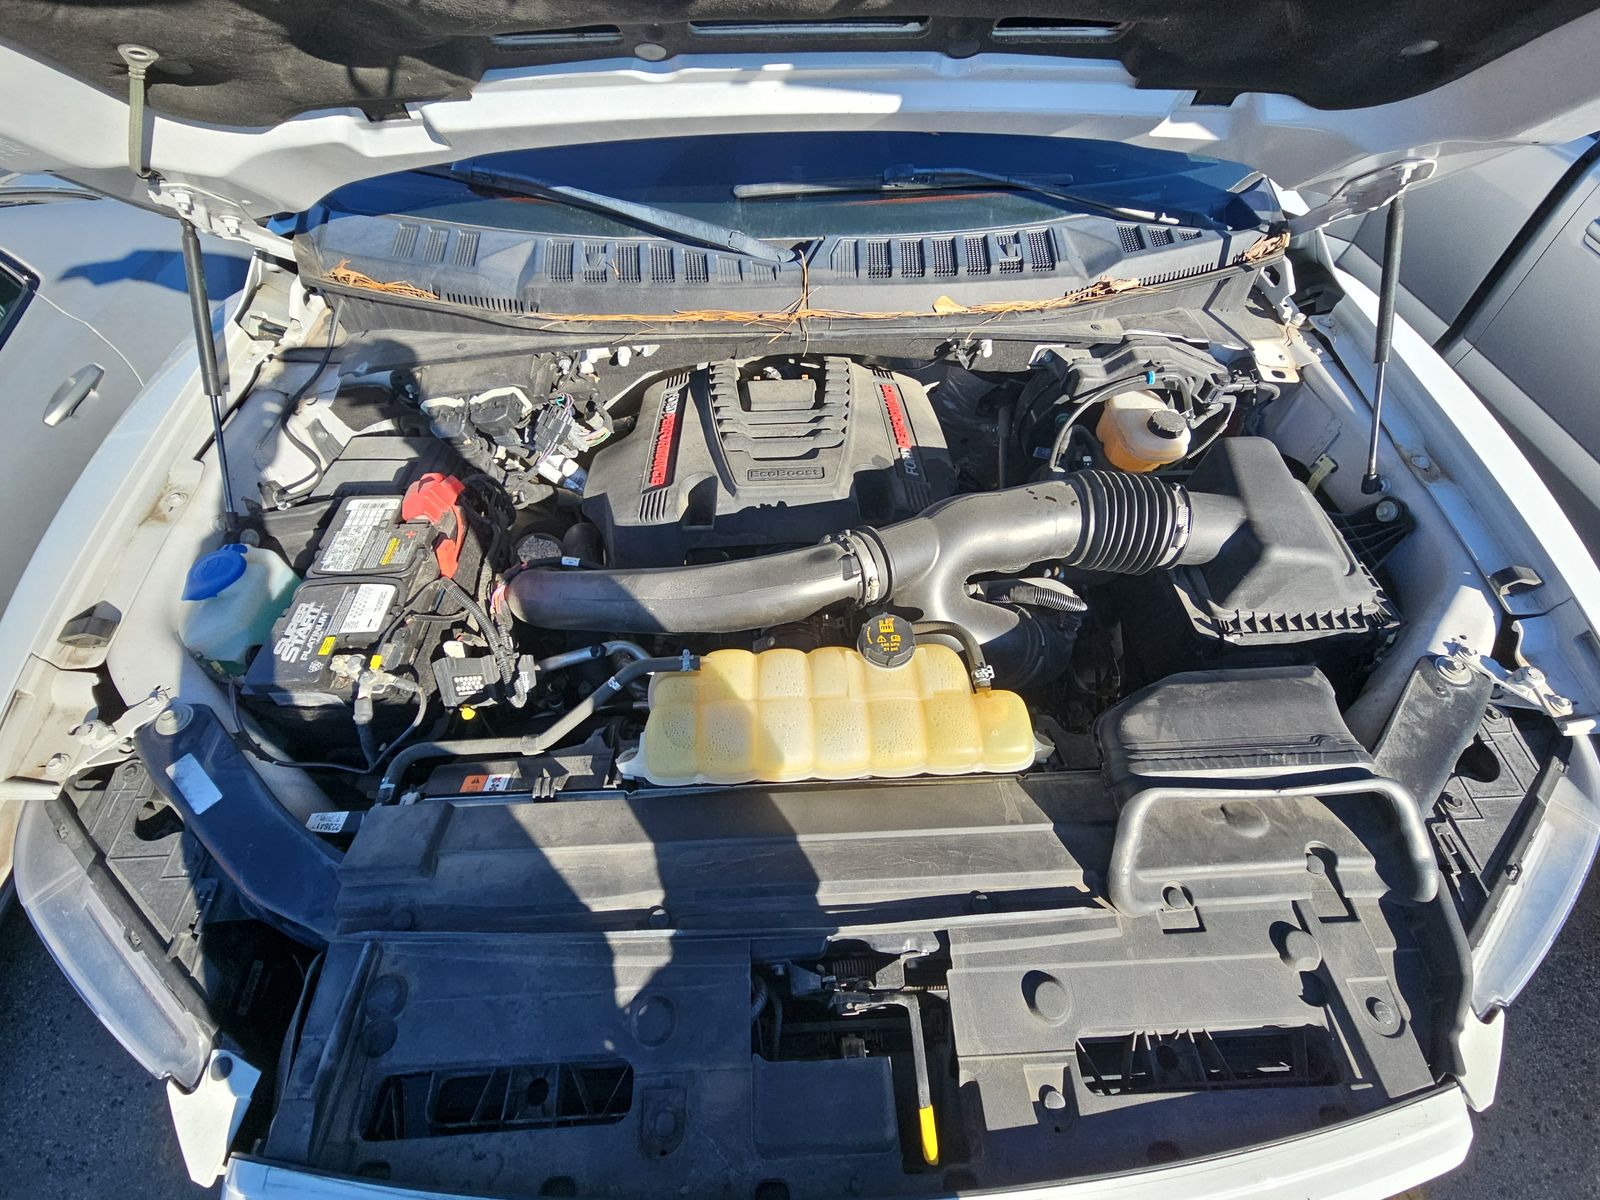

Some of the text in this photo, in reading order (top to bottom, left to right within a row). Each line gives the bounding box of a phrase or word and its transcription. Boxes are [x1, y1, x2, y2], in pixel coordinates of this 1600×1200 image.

[649, 393, 679, 486] FORD PERFORMANCE
[750, 468, 820, 478] EcoBoost
[273, 600, 317, 656] SUPER
[281, 606, 323, 663] START
[300, 611, 330, 661] PLATINUM
